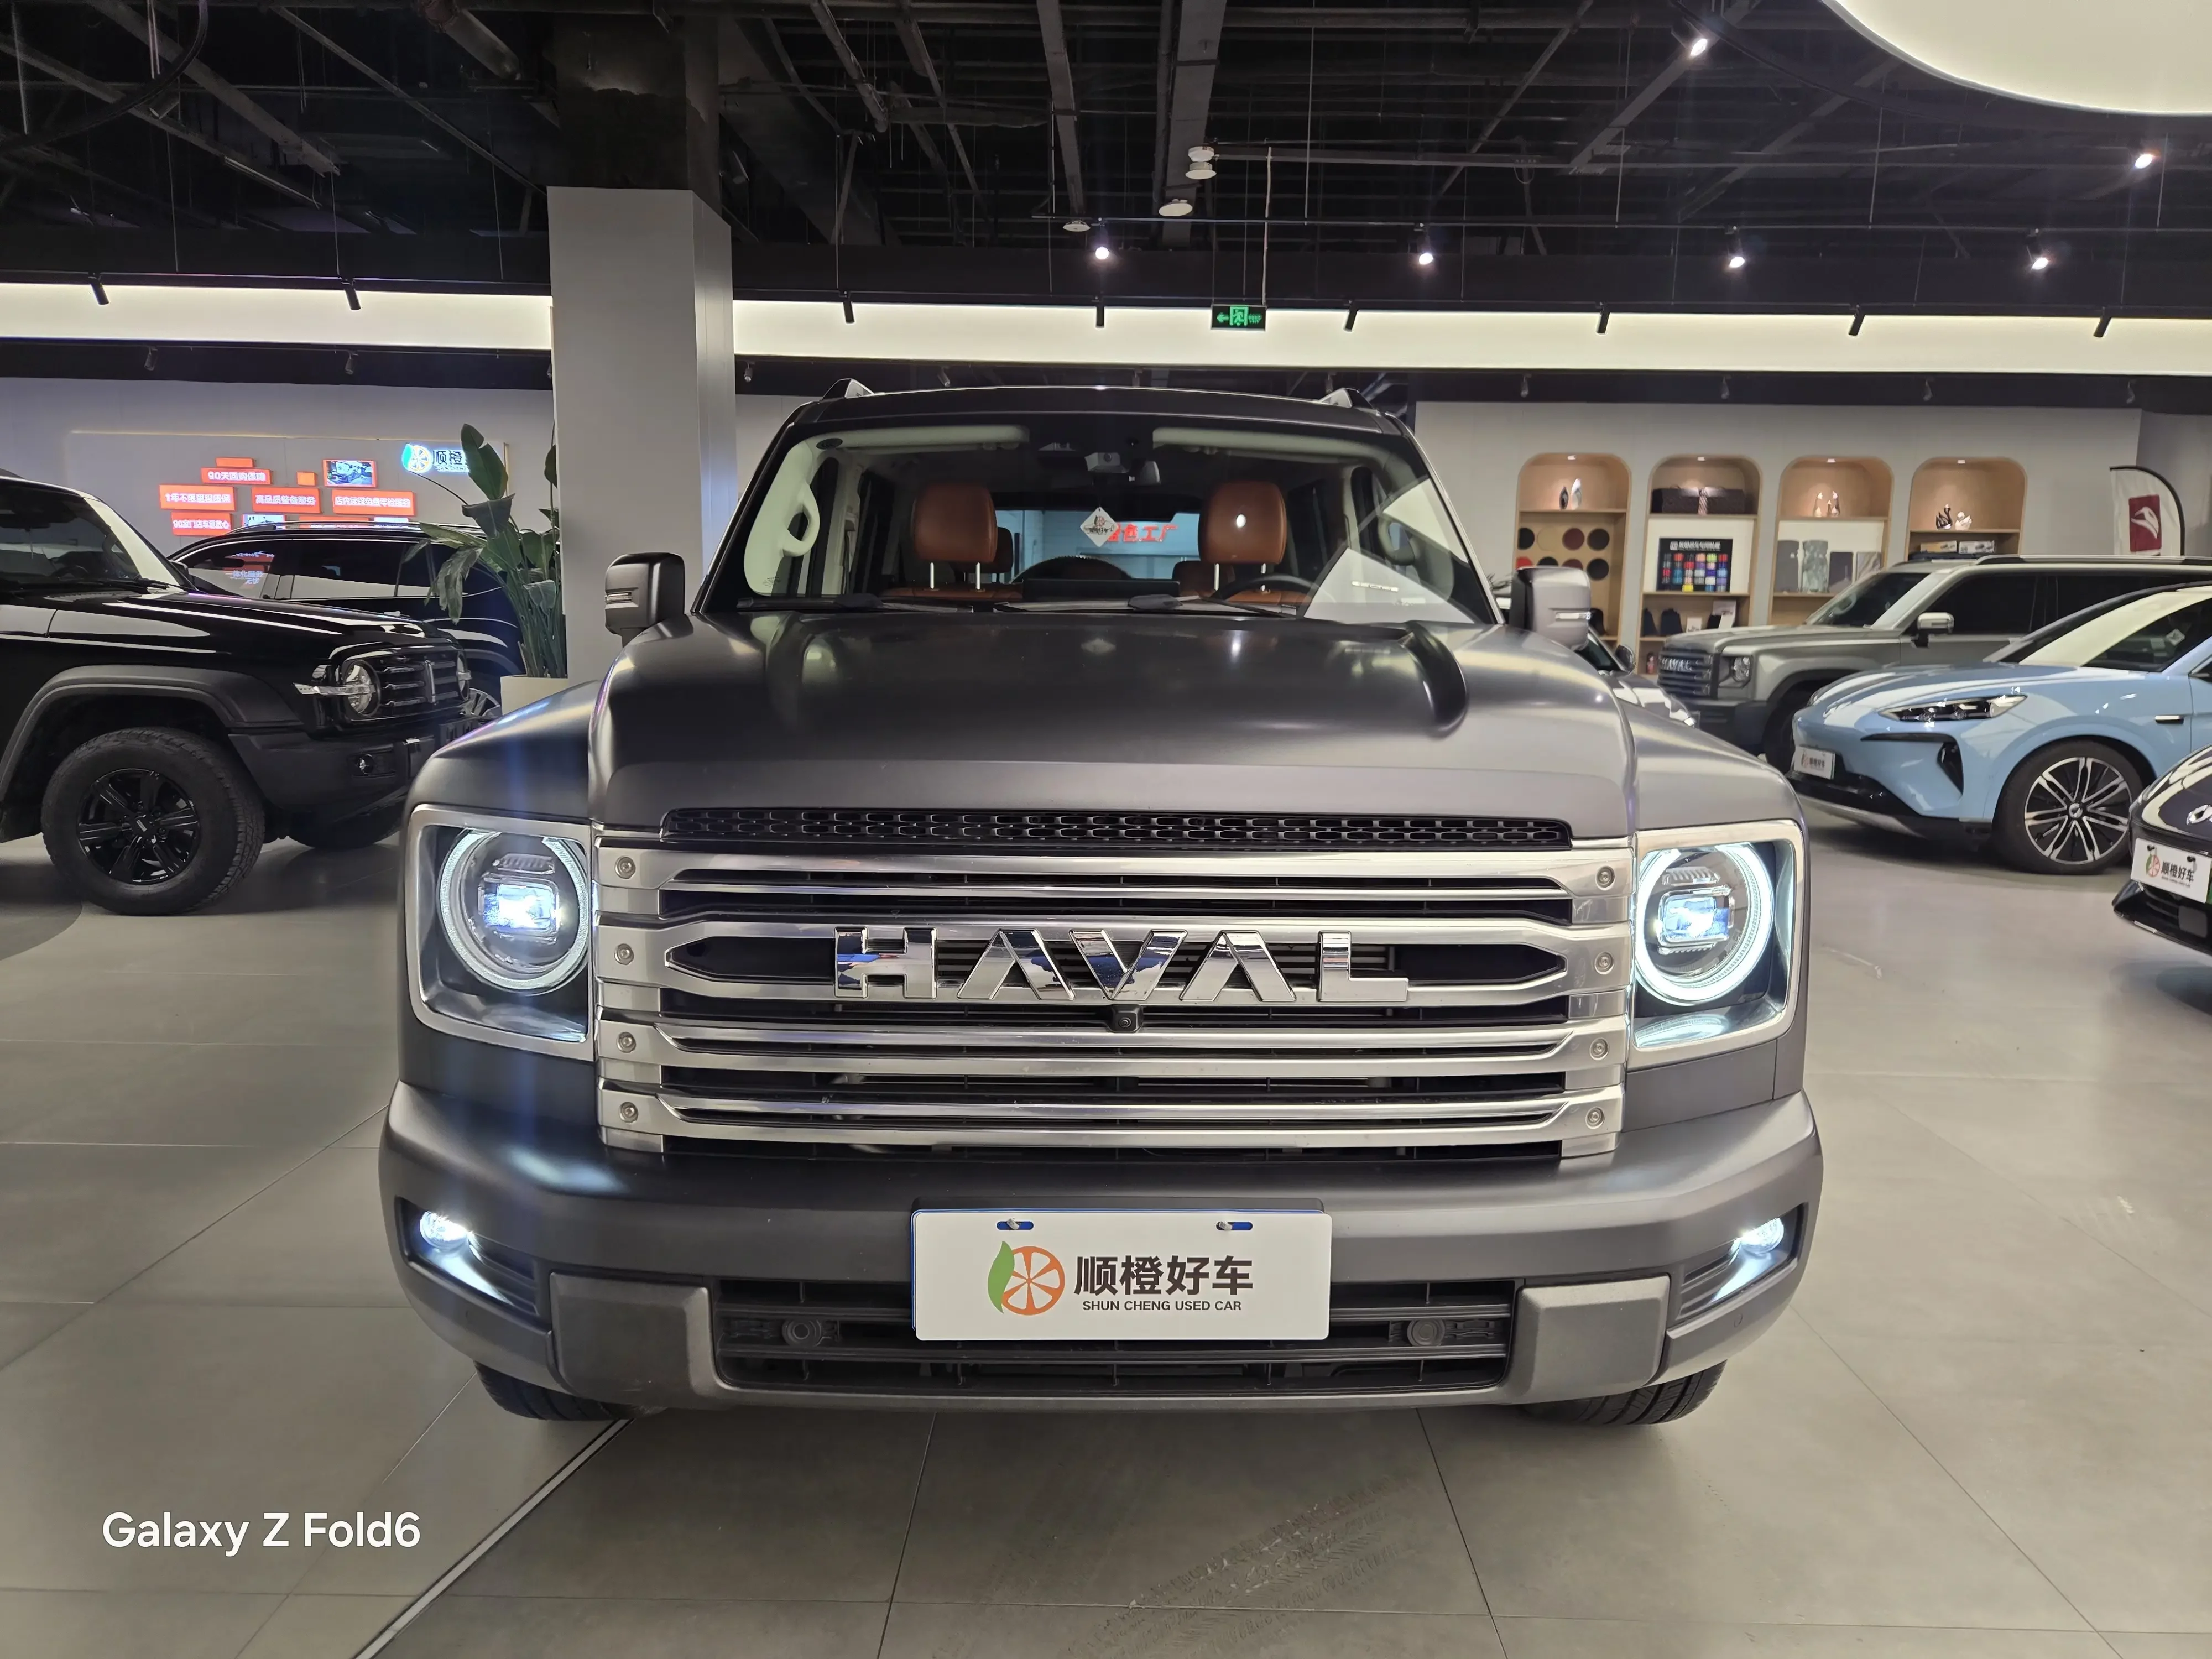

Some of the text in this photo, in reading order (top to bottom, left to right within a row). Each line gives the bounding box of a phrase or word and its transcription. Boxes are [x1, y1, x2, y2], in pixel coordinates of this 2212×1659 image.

[432, 450, 466, 465] 顺橙
[834, 927, 1409, 1002] HAVAL
[1074, 1255, 1254, 1296] 顺橙好车
[1082, 1300, 1242, 1311] SHUN CHENG USED CAR
